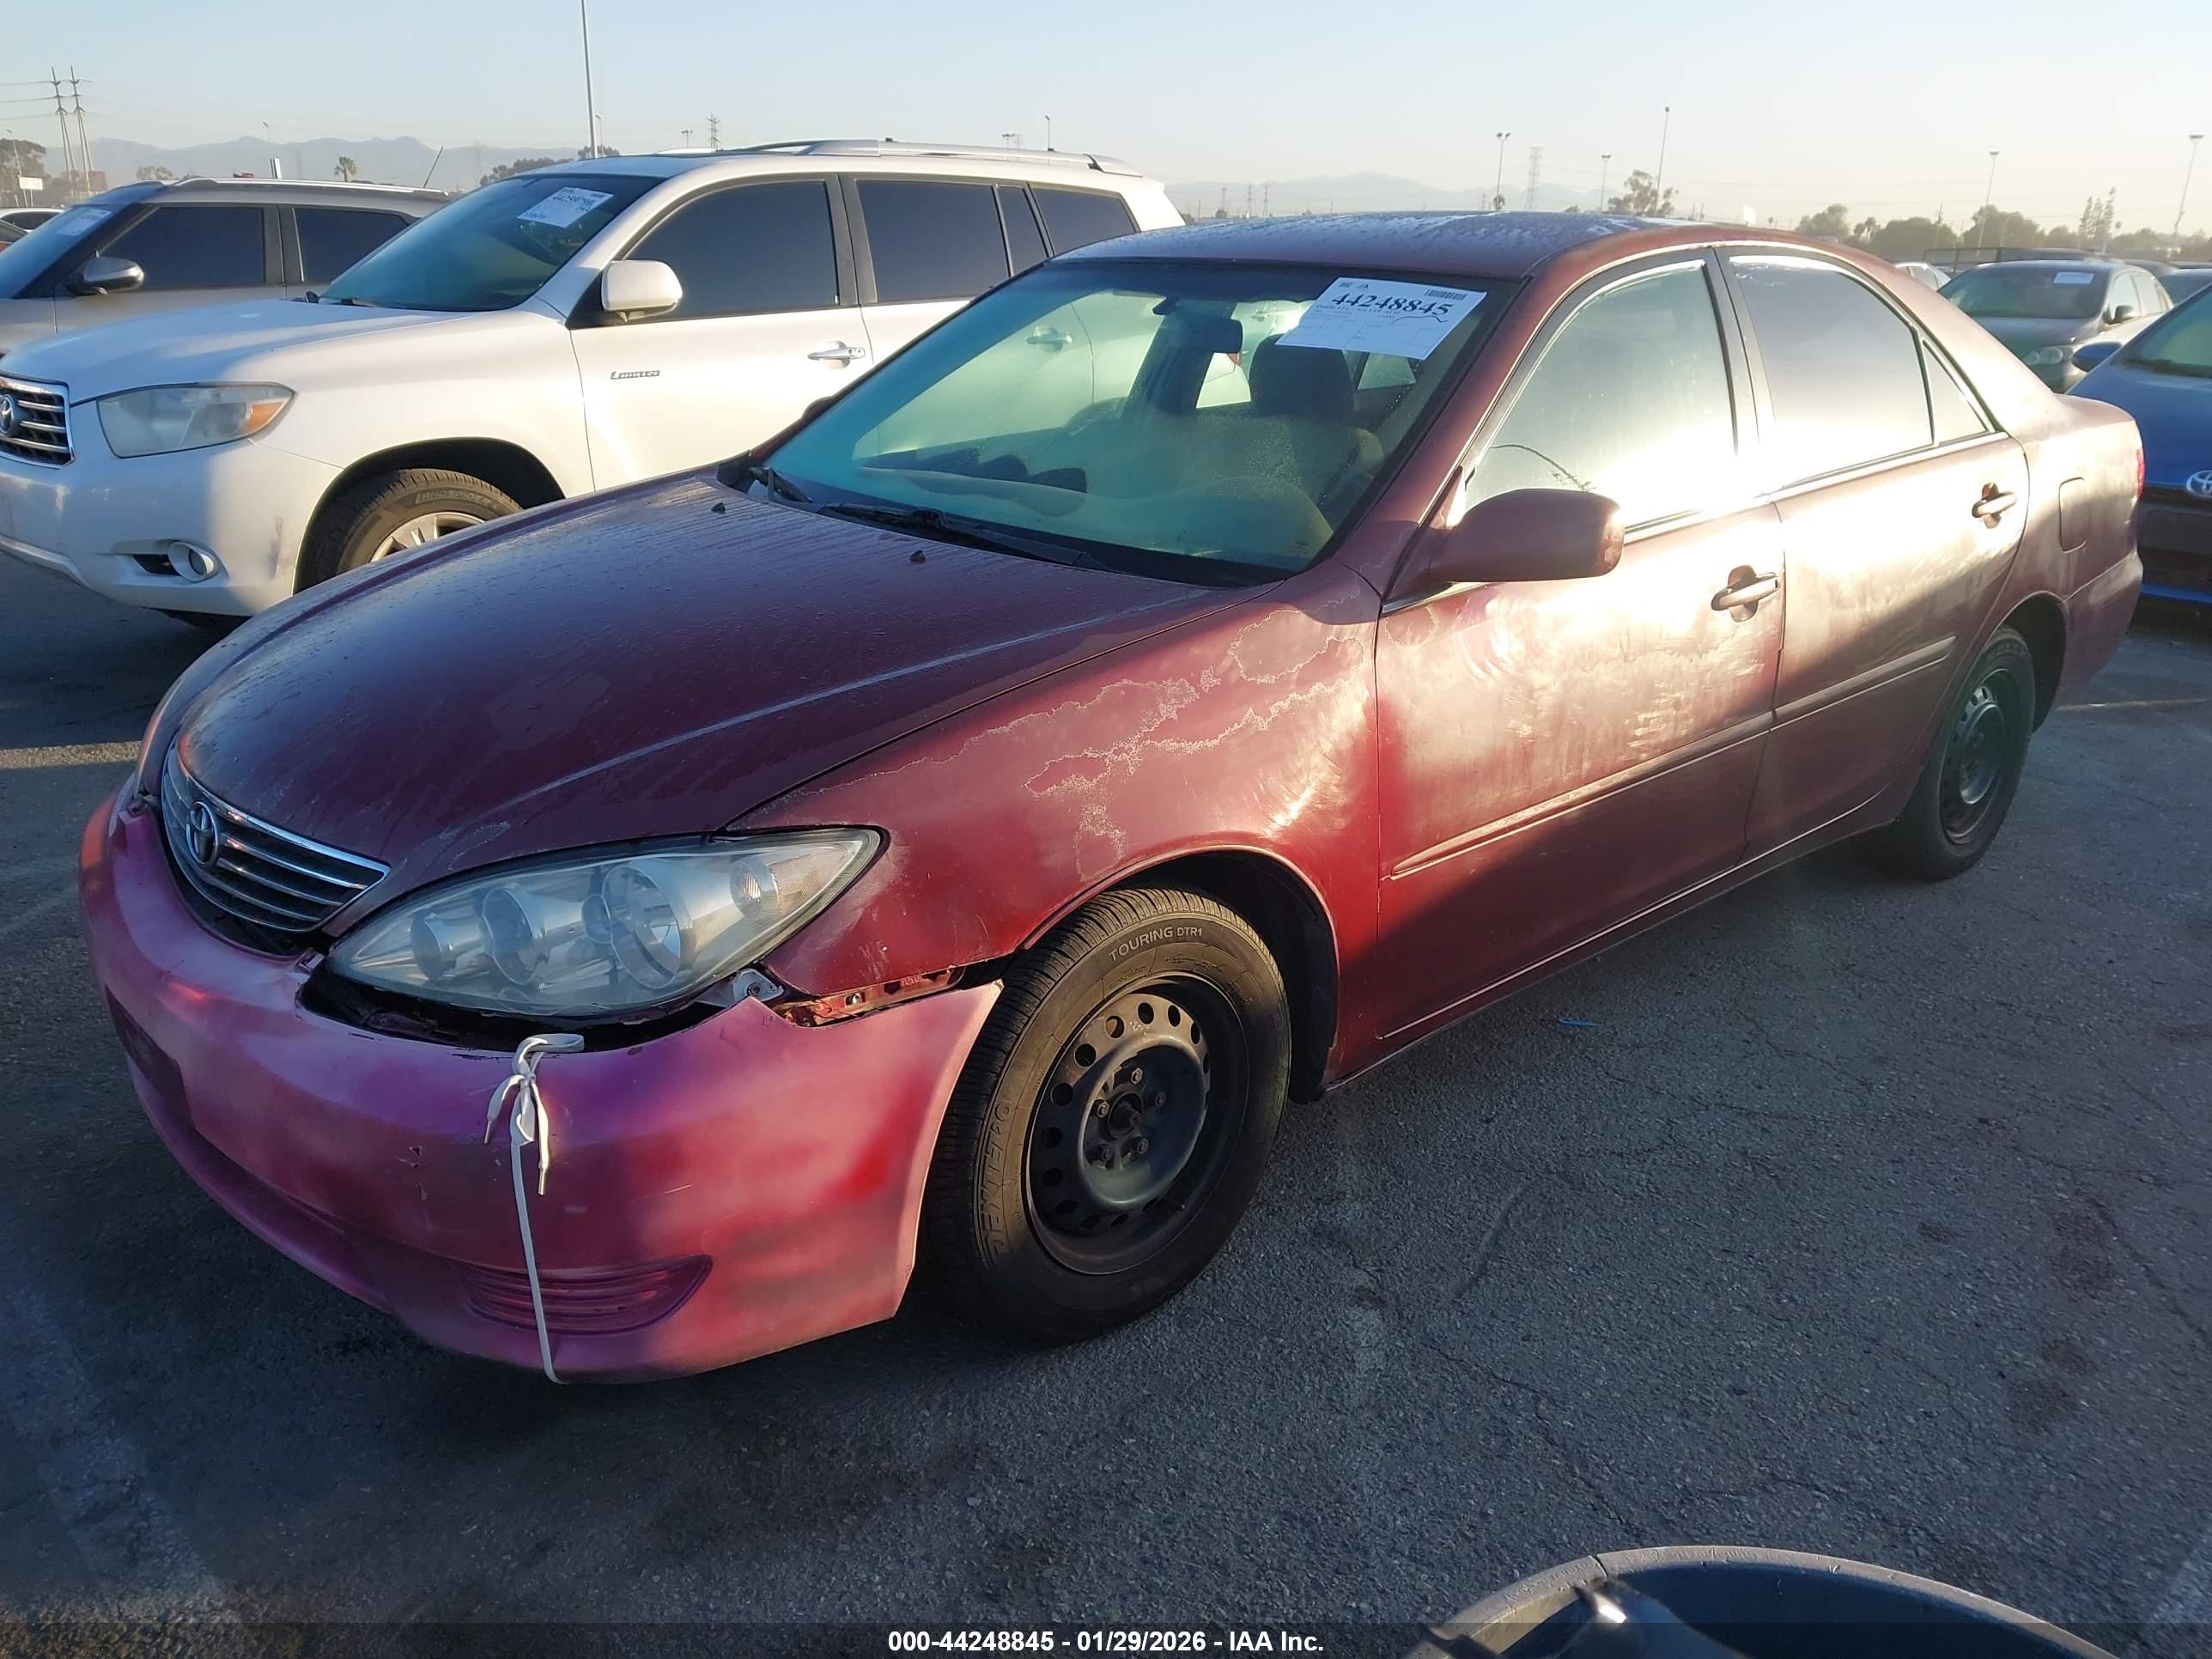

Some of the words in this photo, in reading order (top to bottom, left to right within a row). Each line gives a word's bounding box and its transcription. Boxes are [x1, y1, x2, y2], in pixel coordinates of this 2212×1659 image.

[1332, 293, 1454, 316] 44248845
[416, 489, 491, 506] LANDSPIDER
[1108, 927, 1174, 963] TOURING
[1176, 927, 1203, 939] DTR1
